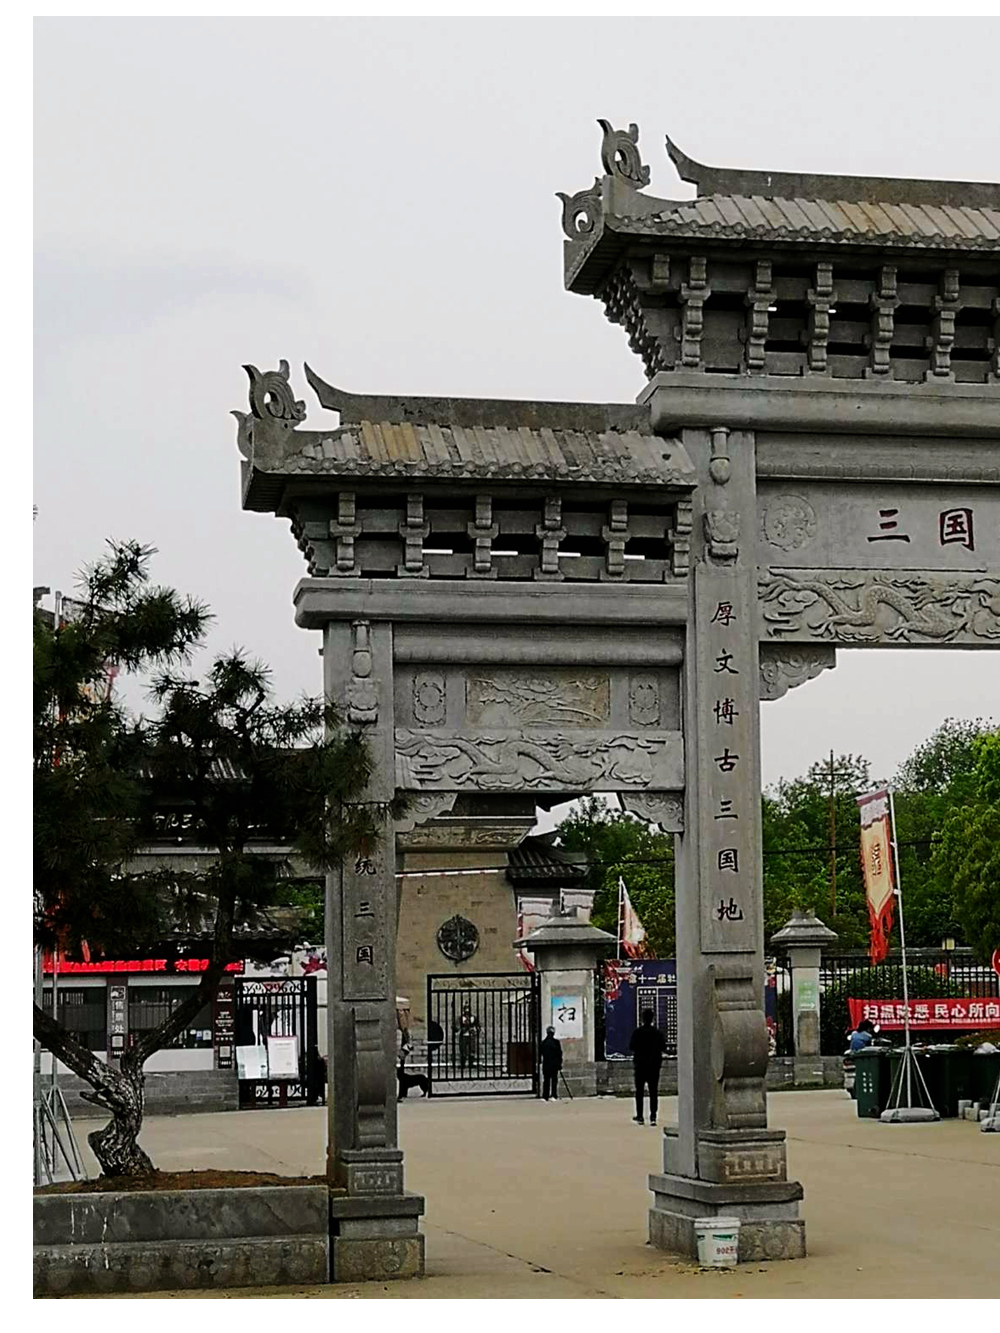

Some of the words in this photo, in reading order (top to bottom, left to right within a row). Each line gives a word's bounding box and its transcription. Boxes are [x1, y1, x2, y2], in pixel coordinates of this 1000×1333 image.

[709, 600, 745, 922] 厚文博古三国地
[353, 856, 377, 966] 统三国
[863, 1004, 930, 1020] 扫黑除恶
[934, 1002, 1000, 1019] 民心所向
